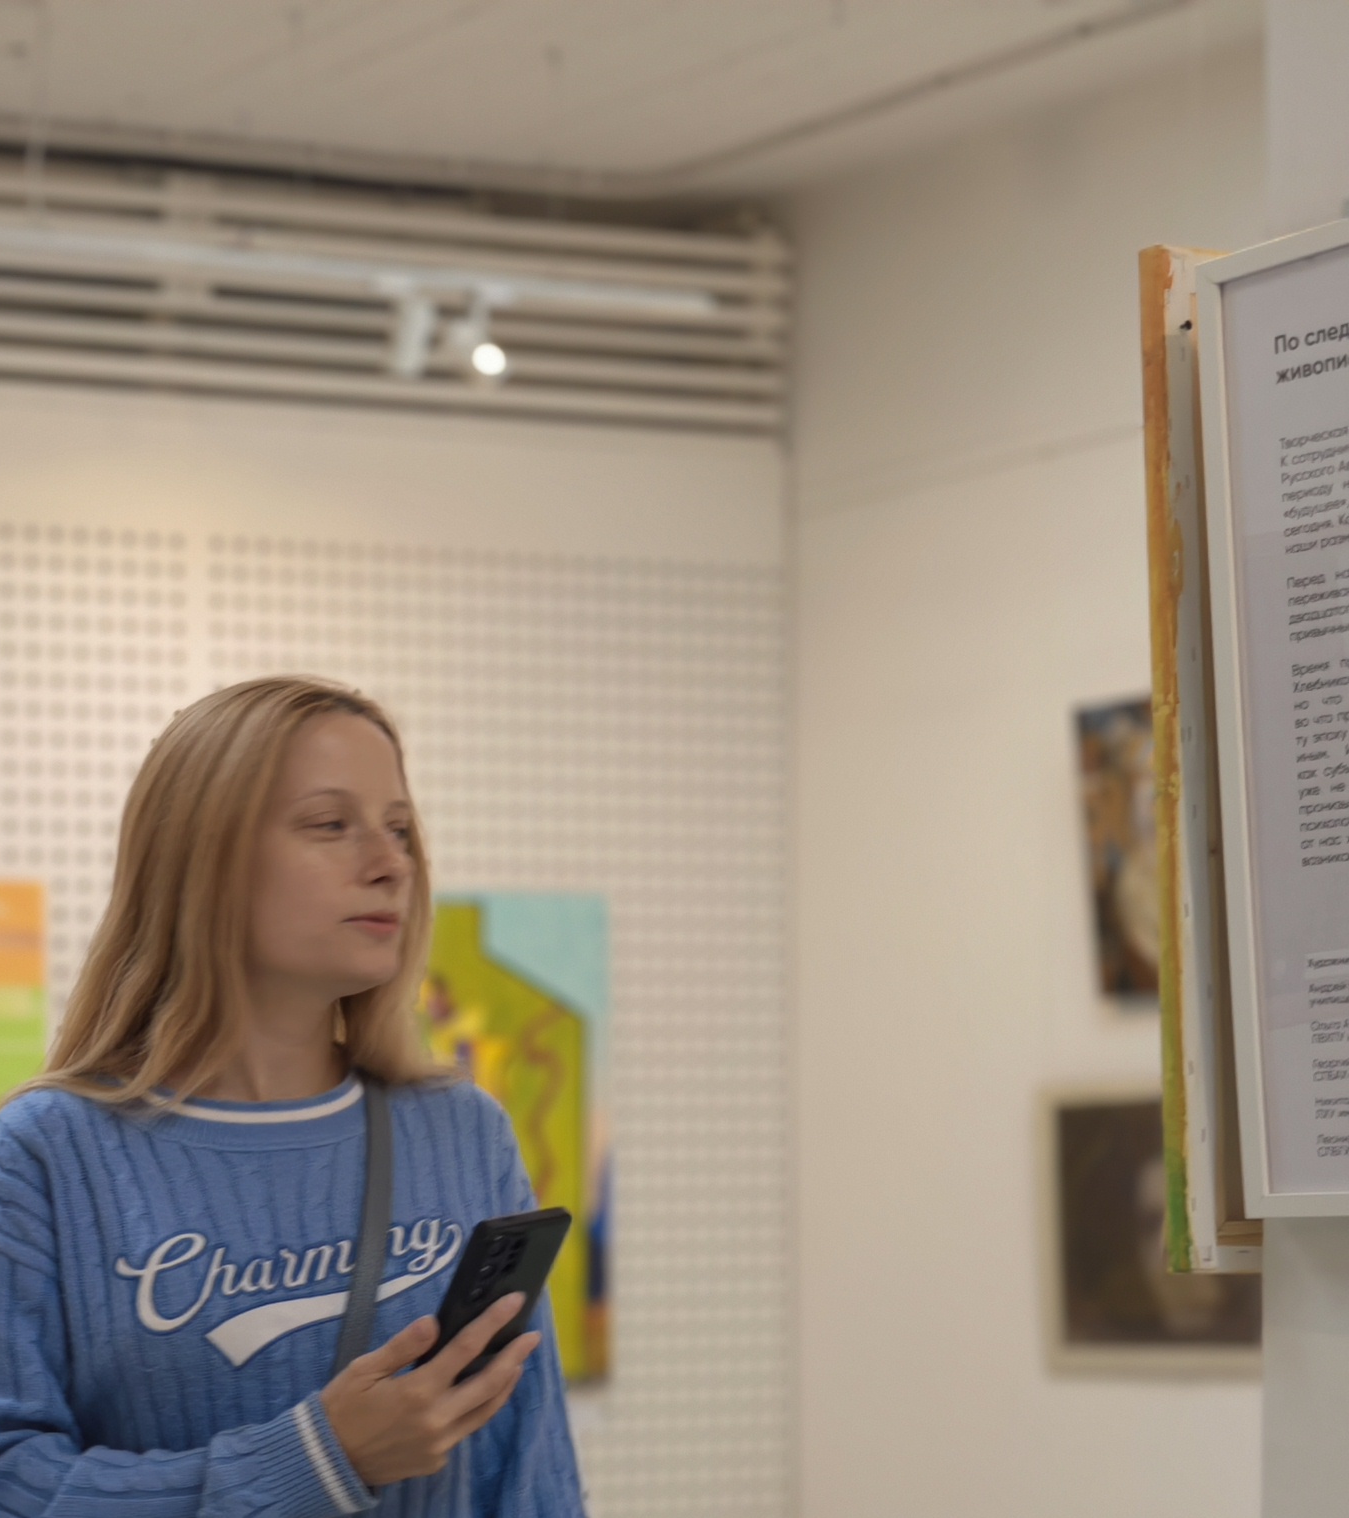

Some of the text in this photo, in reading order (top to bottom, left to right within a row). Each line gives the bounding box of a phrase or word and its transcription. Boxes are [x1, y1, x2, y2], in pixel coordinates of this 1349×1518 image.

[1274, 322, 1349, 355] По след
[1275, 353, 1349, 385] живопи
[1281, 465, 1335, 486] Русского
[1286, 573, 1326, 590] Перед
[115, 1217, 459, 1332] Charmng
